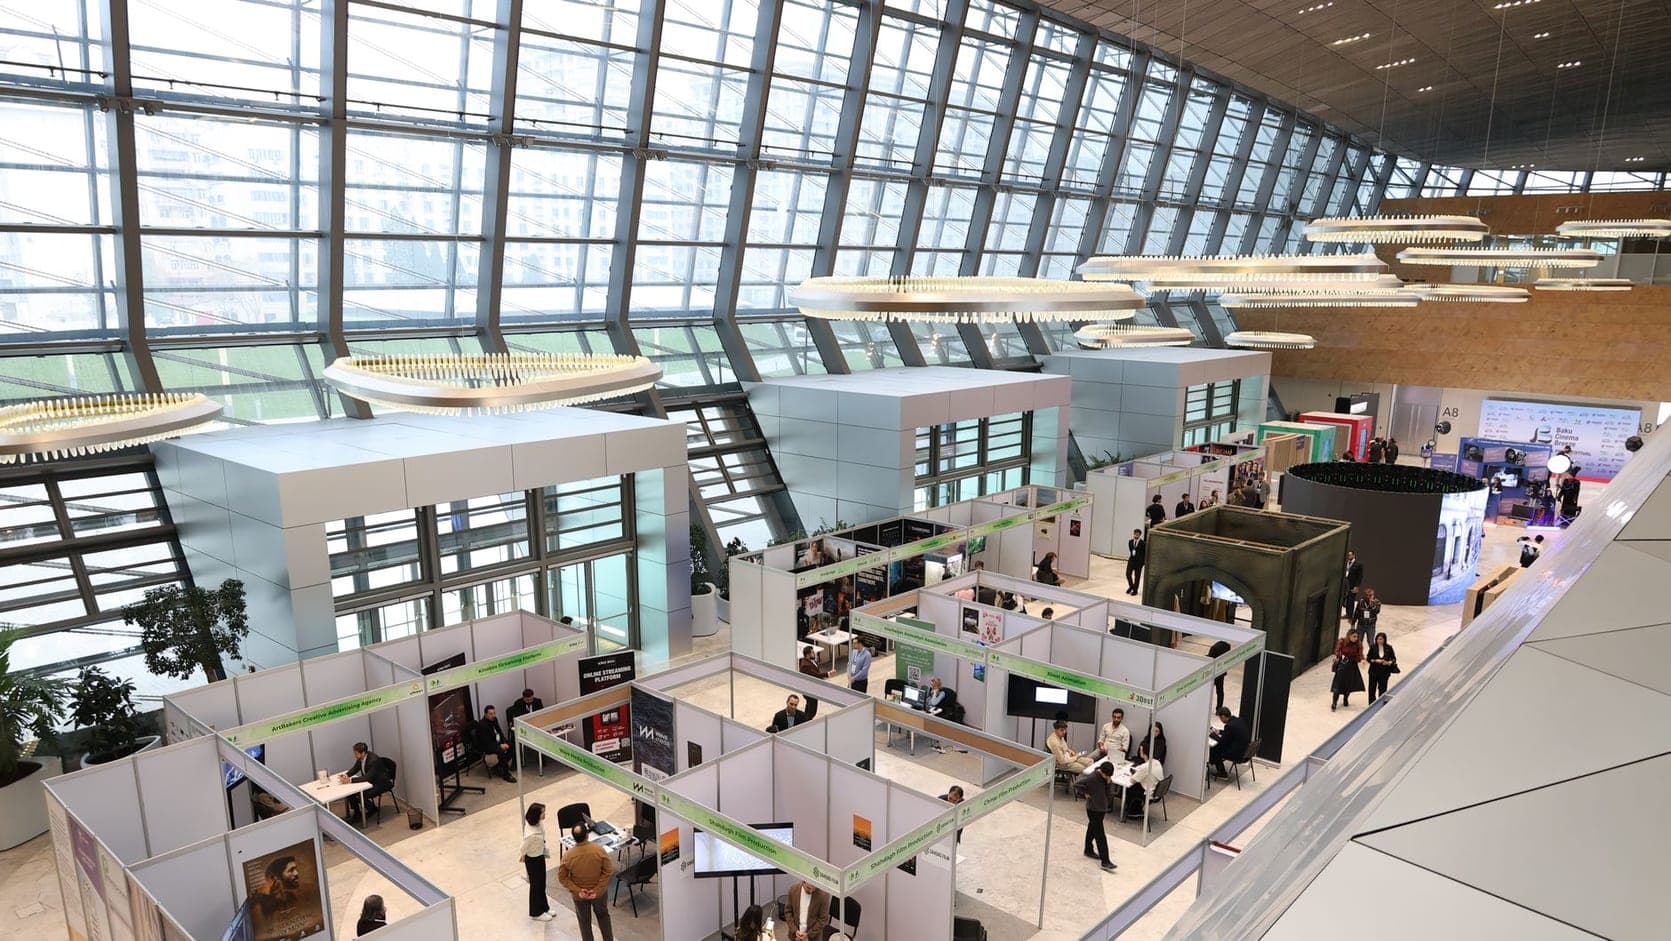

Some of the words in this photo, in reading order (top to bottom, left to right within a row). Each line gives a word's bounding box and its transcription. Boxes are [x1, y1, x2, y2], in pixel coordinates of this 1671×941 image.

[1442, 407, 1459, 417] A8
[1556, 427, 1573, 435] Baku
[1554, 433, 1579, 441] Cinema
[583, 670, 601, 678] ONLINE
[602, 665, 631, 674] STREAMING
[594, 673, 621, 682] PLATFORM
[302, 711, 327, 724] Creative
[328, 701, 360, 715] Advertising
[361, 697, 382, 707] Agency
[747, 837, 777, 855] Production
